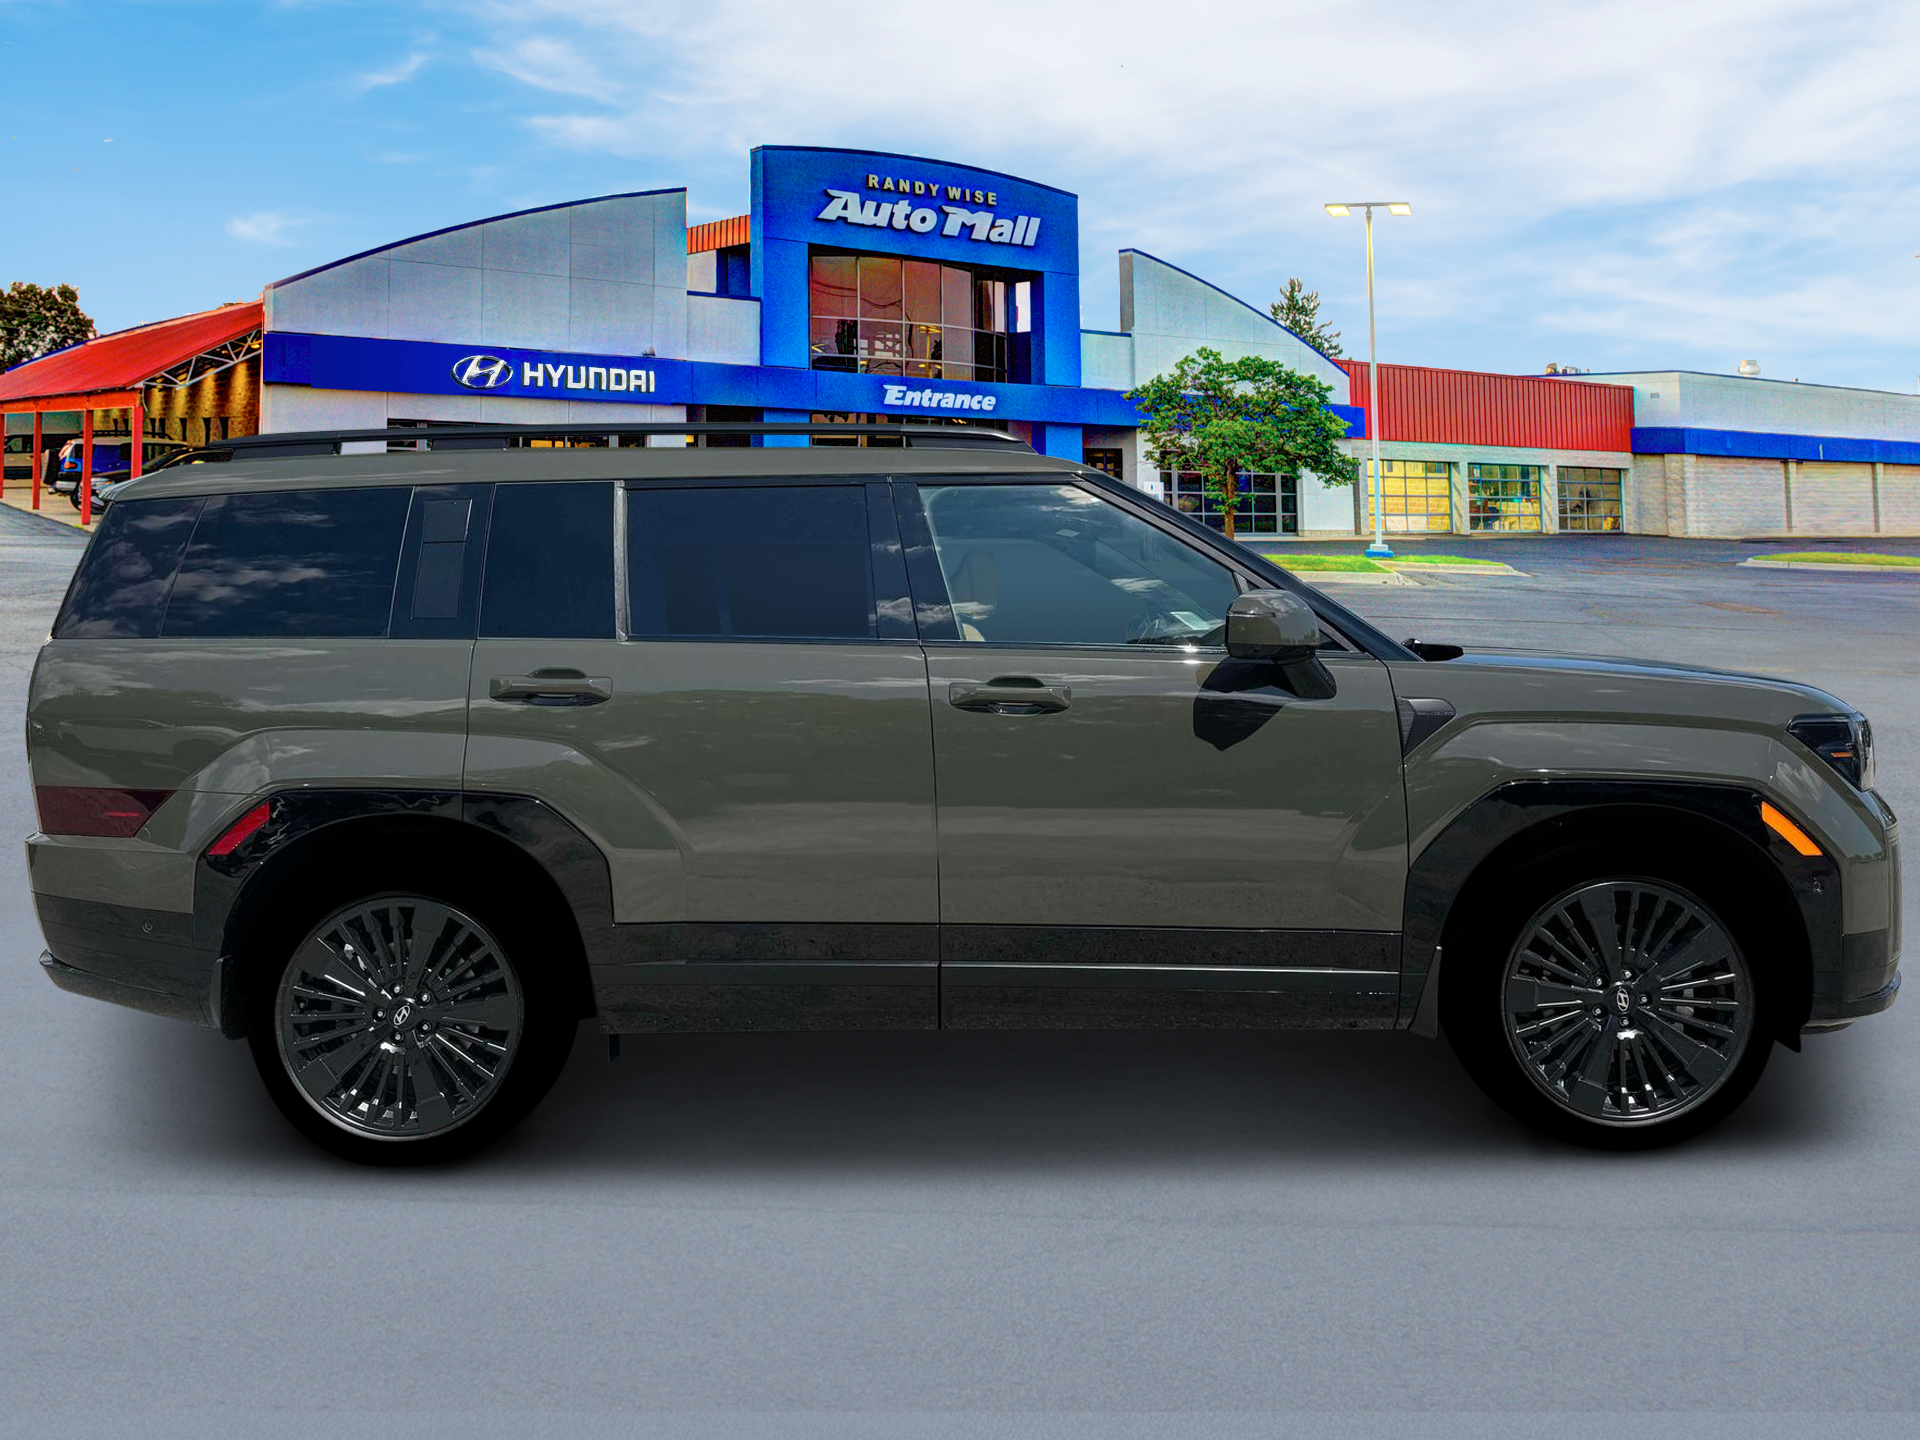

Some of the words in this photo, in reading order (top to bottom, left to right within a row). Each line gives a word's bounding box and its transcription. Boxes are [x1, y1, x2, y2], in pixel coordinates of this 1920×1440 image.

[868, 174, 939, 197] RANDY
[946, 186, 998, 206] WISE
[817, 189, 937, 233] Auto
[941, 206, 1041, 246] Mall
[522, 361, 656, 393] HYUNDAI
[883, 384, 997, 412] Entrance
